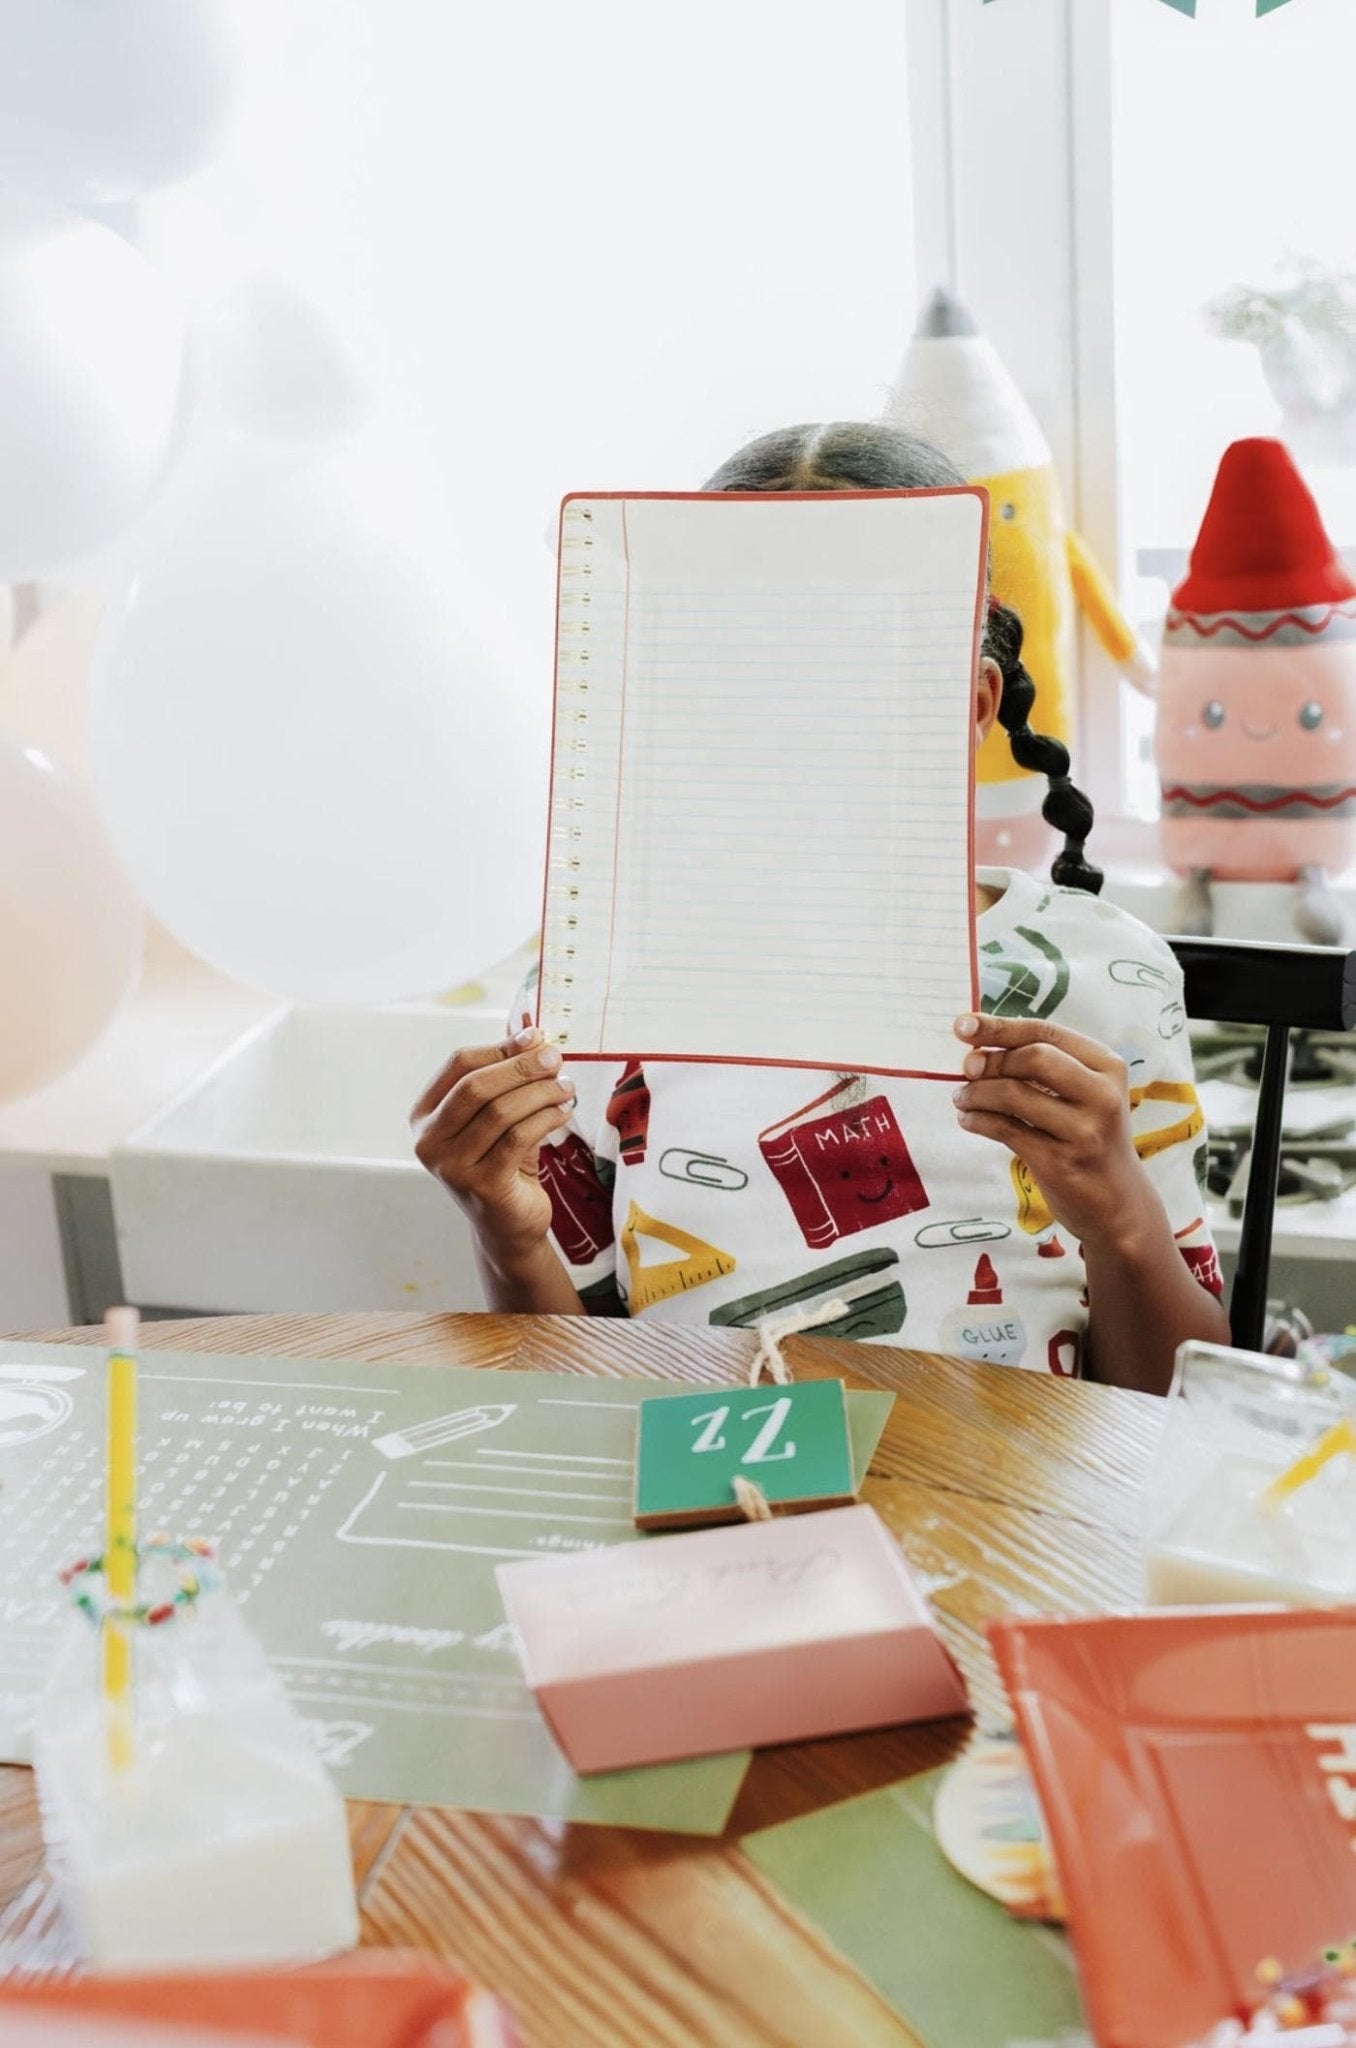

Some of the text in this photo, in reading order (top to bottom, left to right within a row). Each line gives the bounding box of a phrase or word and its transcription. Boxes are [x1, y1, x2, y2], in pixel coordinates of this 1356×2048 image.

[813, 1112, 891, 1151] MATH
[962, 1324, 1018, 1344] GLUE
[258, 1402, 283, 1416] to
[295, 1404, 356, 1418] want
[366, 1410, 386, 1424] I
[157, 1408, 369, 1438] When I grow up
